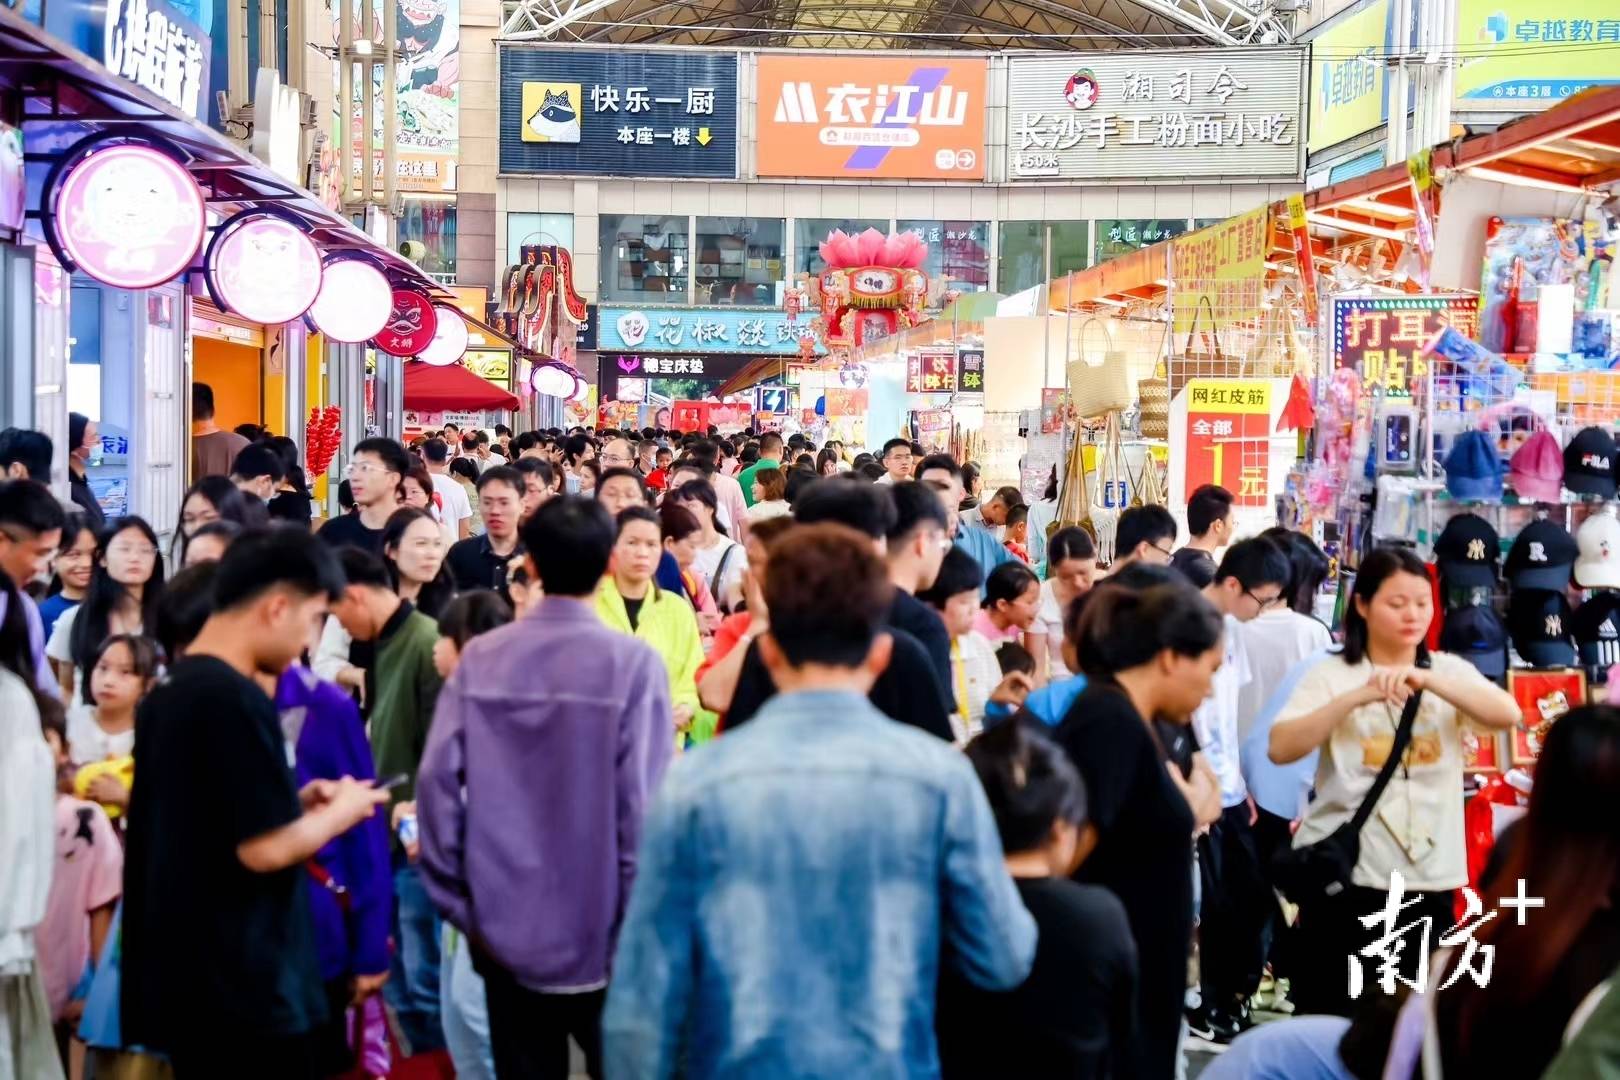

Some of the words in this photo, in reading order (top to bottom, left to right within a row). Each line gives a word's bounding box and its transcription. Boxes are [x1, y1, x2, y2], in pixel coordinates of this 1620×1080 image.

[1515, 19, 1620, 42] 卓越教育
[1121, 65, 1248, 104] 湘司令
[1506, 85, 1552, 97] 本座3层
[591, 85, 715, 114] 快乐一厨
[824, 83, 968, 125] 衣江山
[617, 126, 690, 146] 本座一楼
[1016, 111, 1293, 149] 长沙手工粉面小吃
[1108, 226, 1137, 243] 型匠
[643, 357, 704, 374] 穗宝床垫
[1192, 388, 1265, 405] 网红皮筋
[1192, 419, 1233, 436] 全部
[1239, 468, 1265, 496] 元
